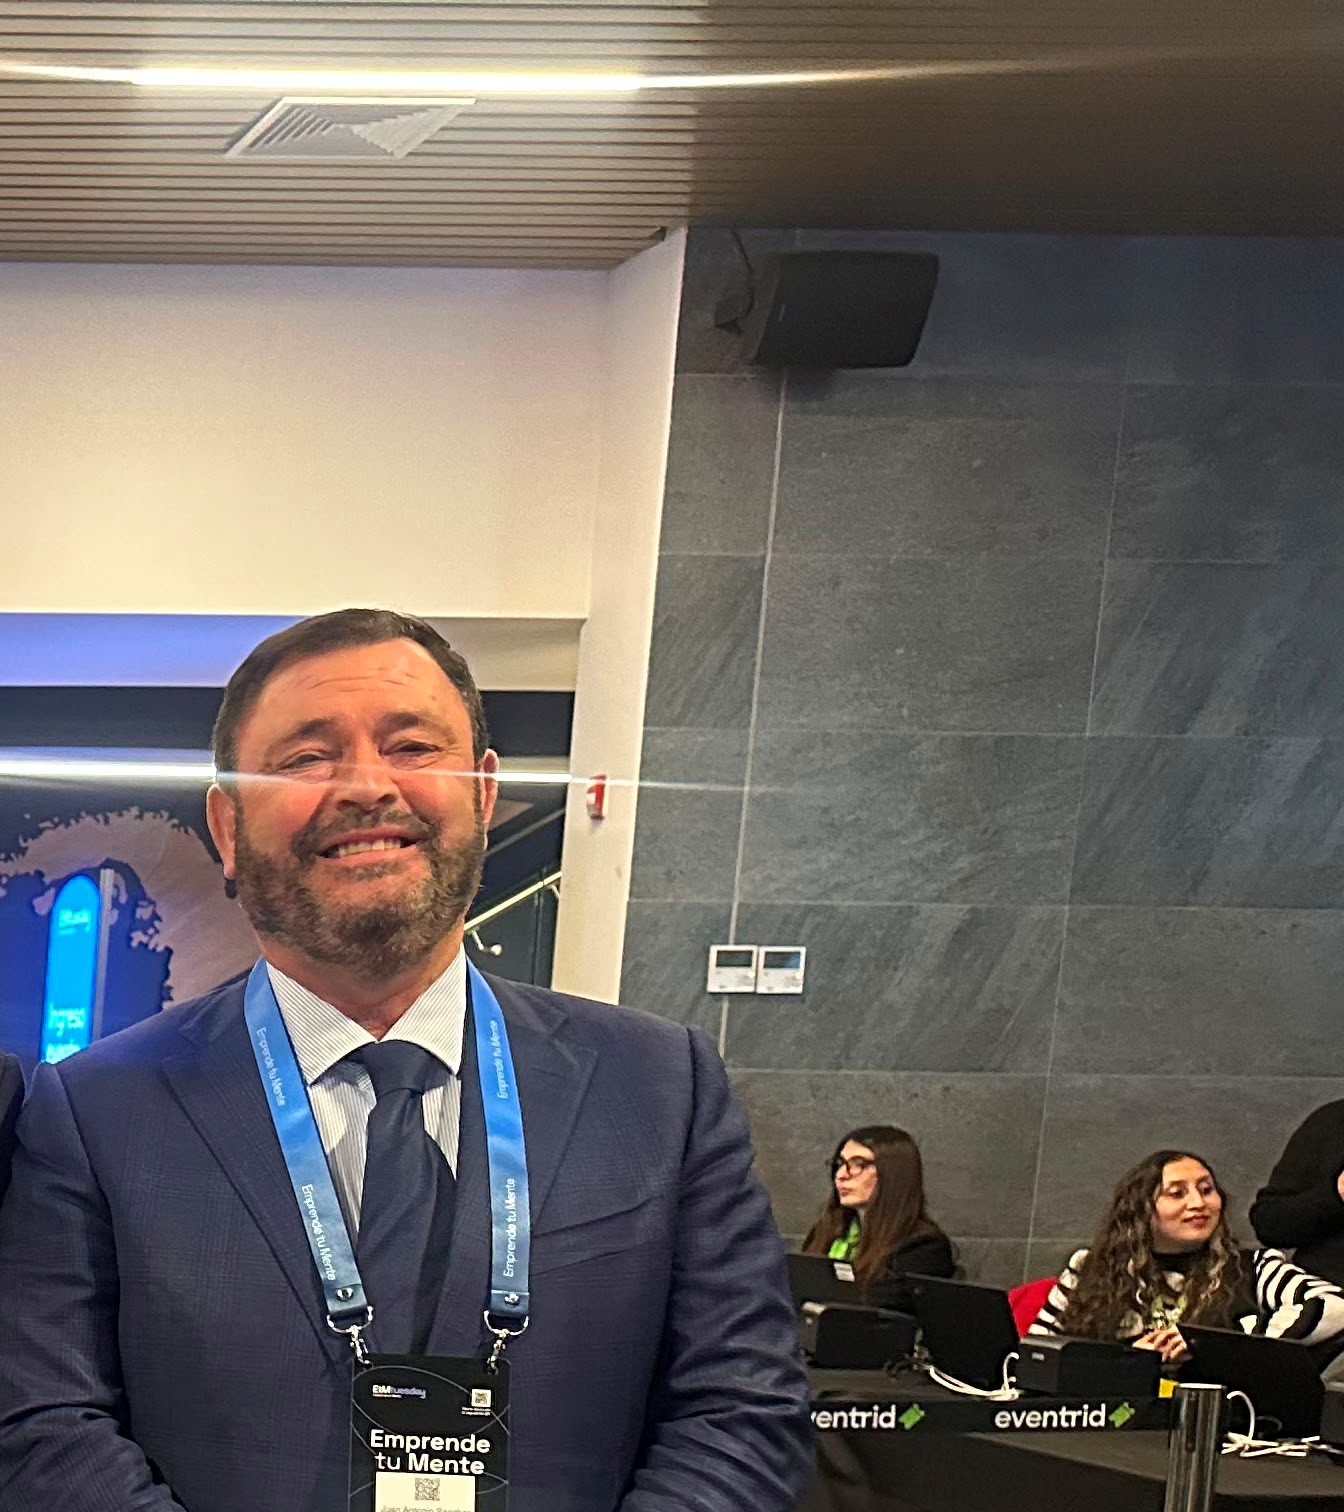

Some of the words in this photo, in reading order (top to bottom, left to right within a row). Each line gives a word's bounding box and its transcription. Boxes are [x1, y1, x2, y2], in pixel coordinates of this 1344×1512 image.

[504, 1177, 516, 1211] Mente
[302, 1183, 323, 1235] Emprende
[505, 1211, 517, 1223] tu
[316, 1235, 326, 1248] tu
[503, 1223, 518, 1278] Emprende
[320, 1247, 337, 1281] Mente
[811, 1404, 896, 1429] entrid
[994, 1403, 1106, 1429] eventrid
[370, 1429, 491, 1453] Emprende
[374, 1452, 401, 1470] tu
[408, 1453, 485, 1475] Mente
